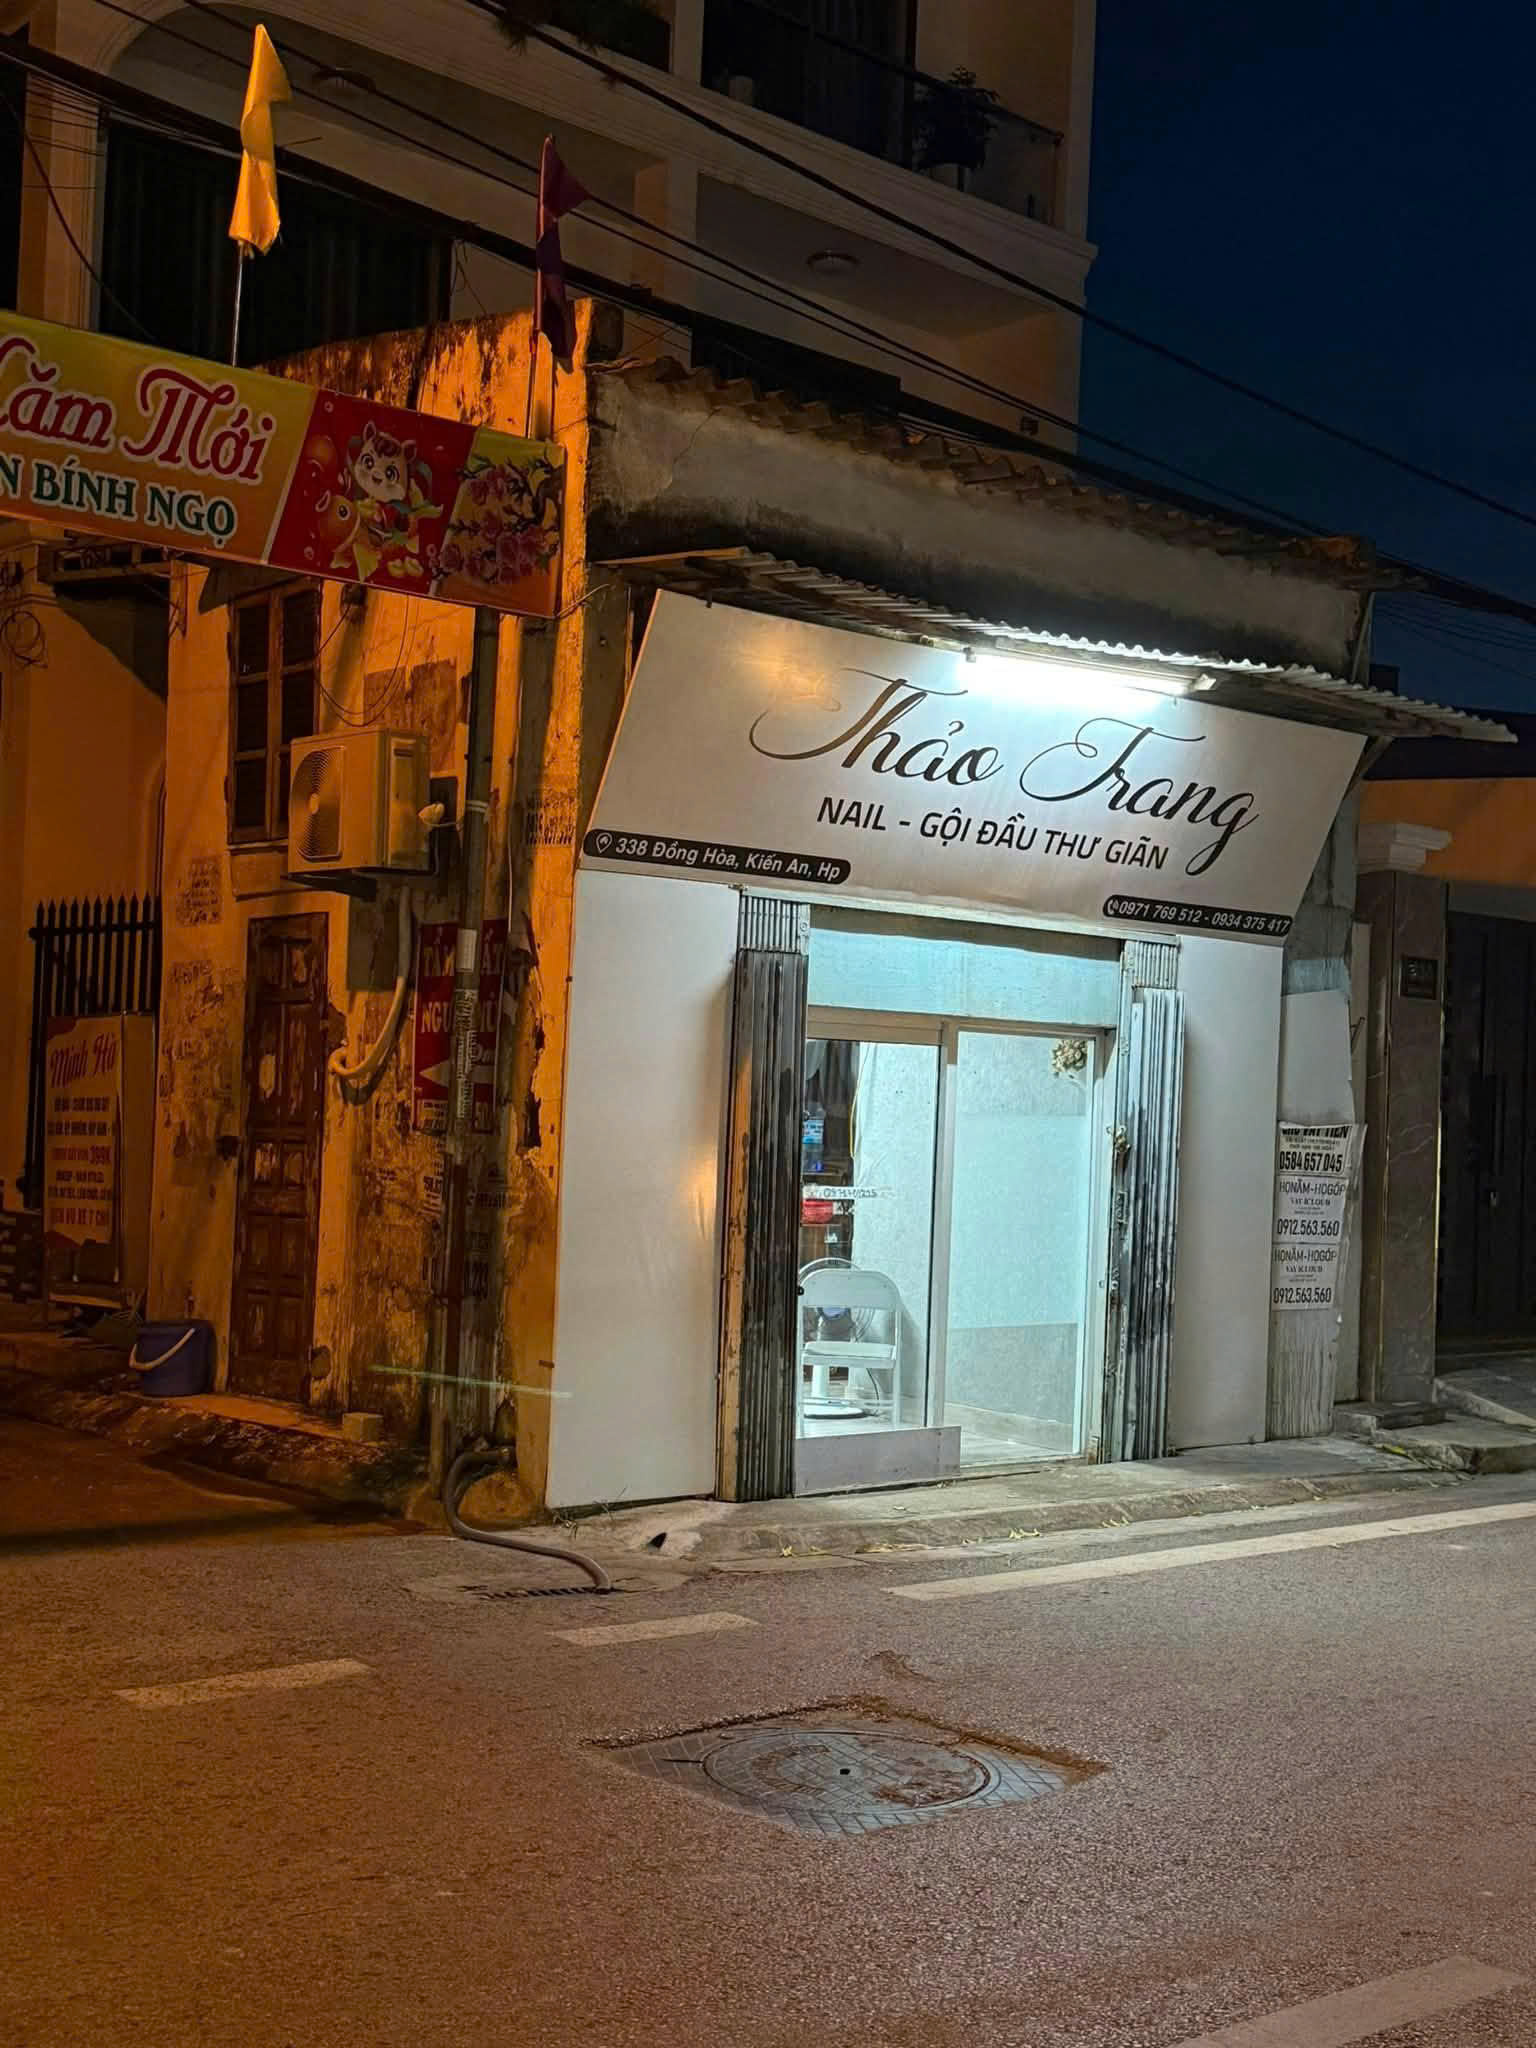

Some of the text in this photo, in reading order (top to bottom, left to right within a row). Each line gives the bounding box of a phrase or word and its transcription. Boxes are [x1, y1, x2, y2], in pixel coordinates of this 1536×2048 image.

[123, 368, 274, 480] Mới
[34, 457, 137, 517] BÍNH
[147, 487, 235, 545] NGỌ
[749, 668, 1259, 876] Thảo Trang
[615, 837, 648, 856] 338
[652, 839, 698, 865] Đồng
[745, 852, 783, 872] Kiến
[786, 859, 813, 876] An,
[816, 862, 840, 880] Hp
[817, 796, 887, 831] NAIL
[920, 807, 972, 847] GỘI
[976, 812, 1038, 851] ĐẦU
[1043, 830, 1103, 860] THƯ
[1105, 836, 1170, 870] GIÃN
[1118, 900, 1149, 917] 0971
[1153, 905, 1177, 920] 769
[1178, 908, 1203, 923] 512
[1211, 912, 1241, 927] 0934
[1242, 915, 1265, 930] 375
[1267, 918, 1290, 932] 417
